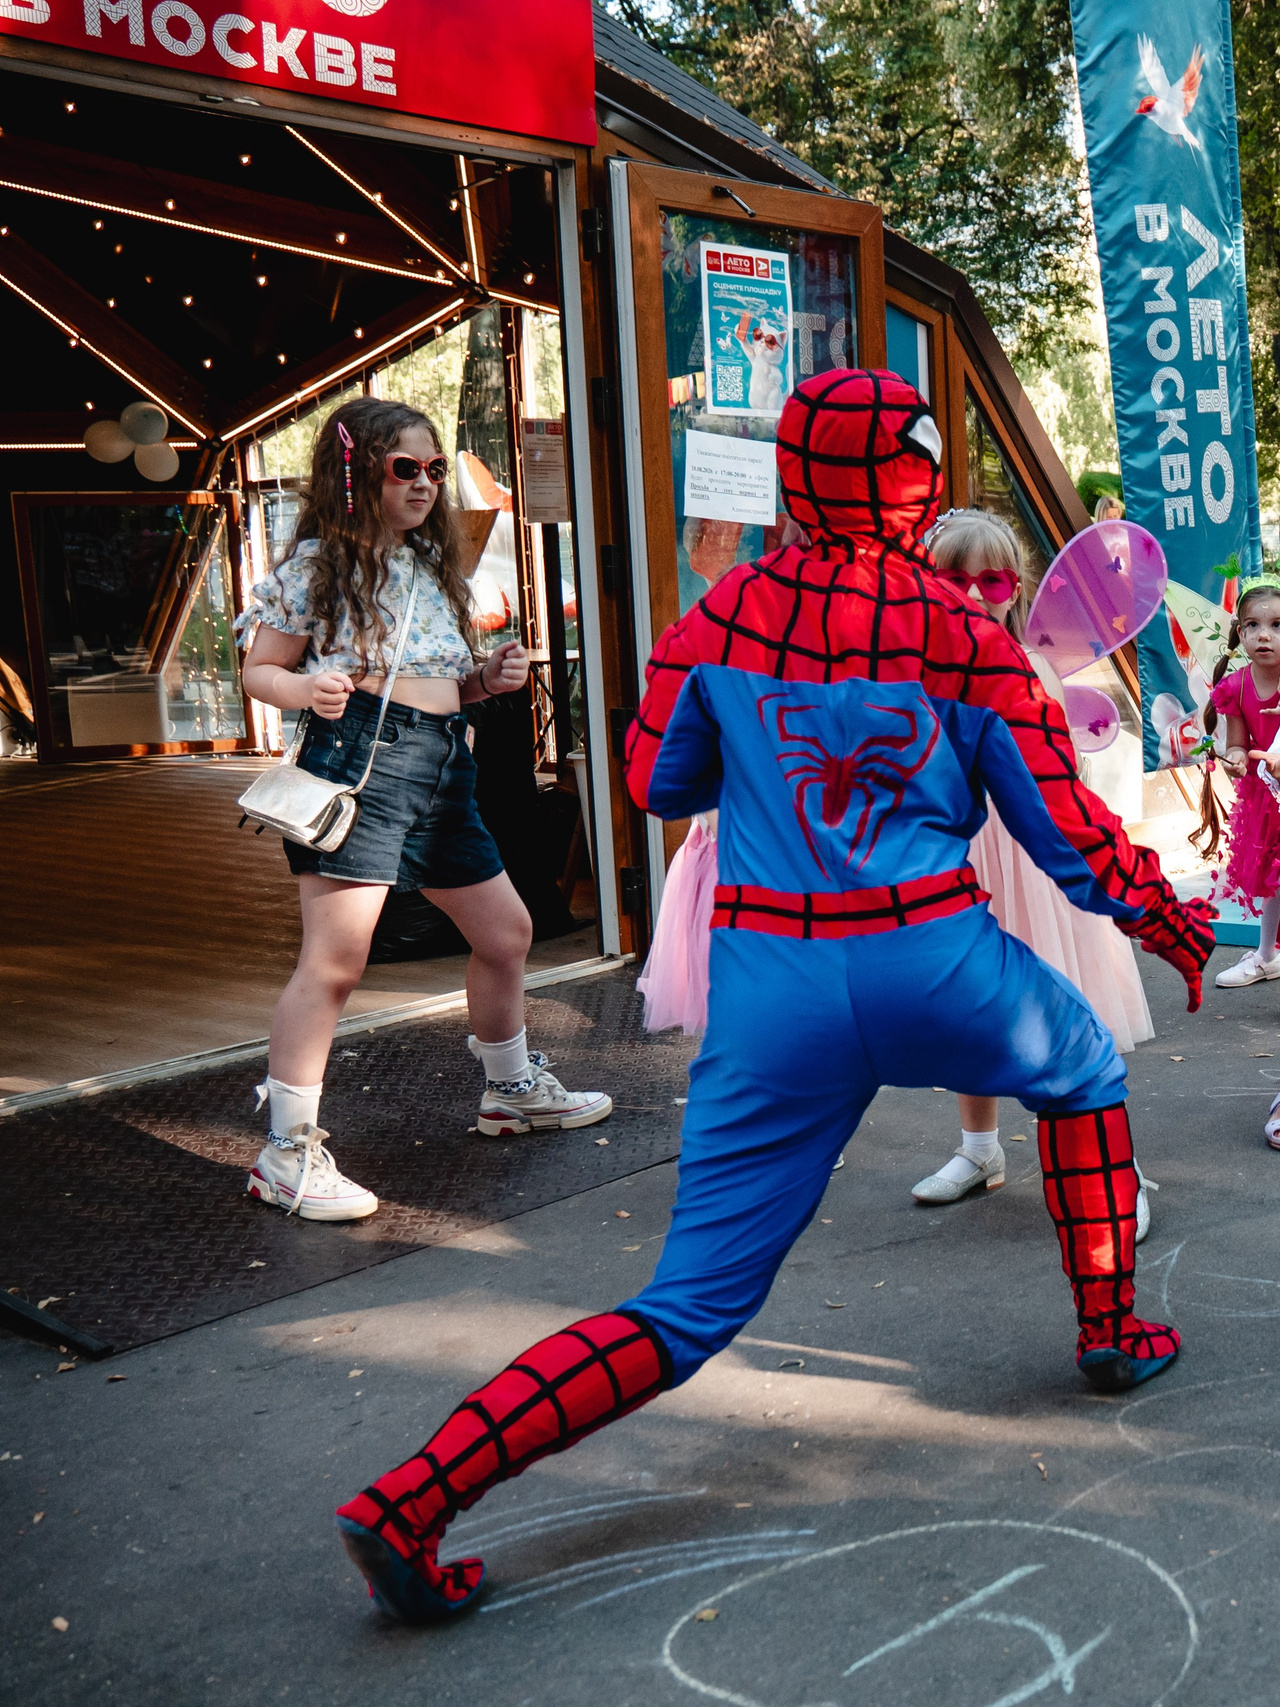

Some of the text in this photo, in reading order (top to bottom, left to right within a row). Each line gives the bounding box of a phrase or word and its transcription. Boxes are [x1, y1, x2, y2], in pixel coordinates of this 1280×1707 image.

[84, 0, 397, 96] МОСКВЕ
[713, 282, 782, 296] ОЦЕНИТЕ ПЛОЩАДКУ
[727, 256, 751, 268] ЛЕТО
[1134, 203, 1196, 531] В МОСКВЕ
[1180, 205, 1234, 524] ЛЕТО
